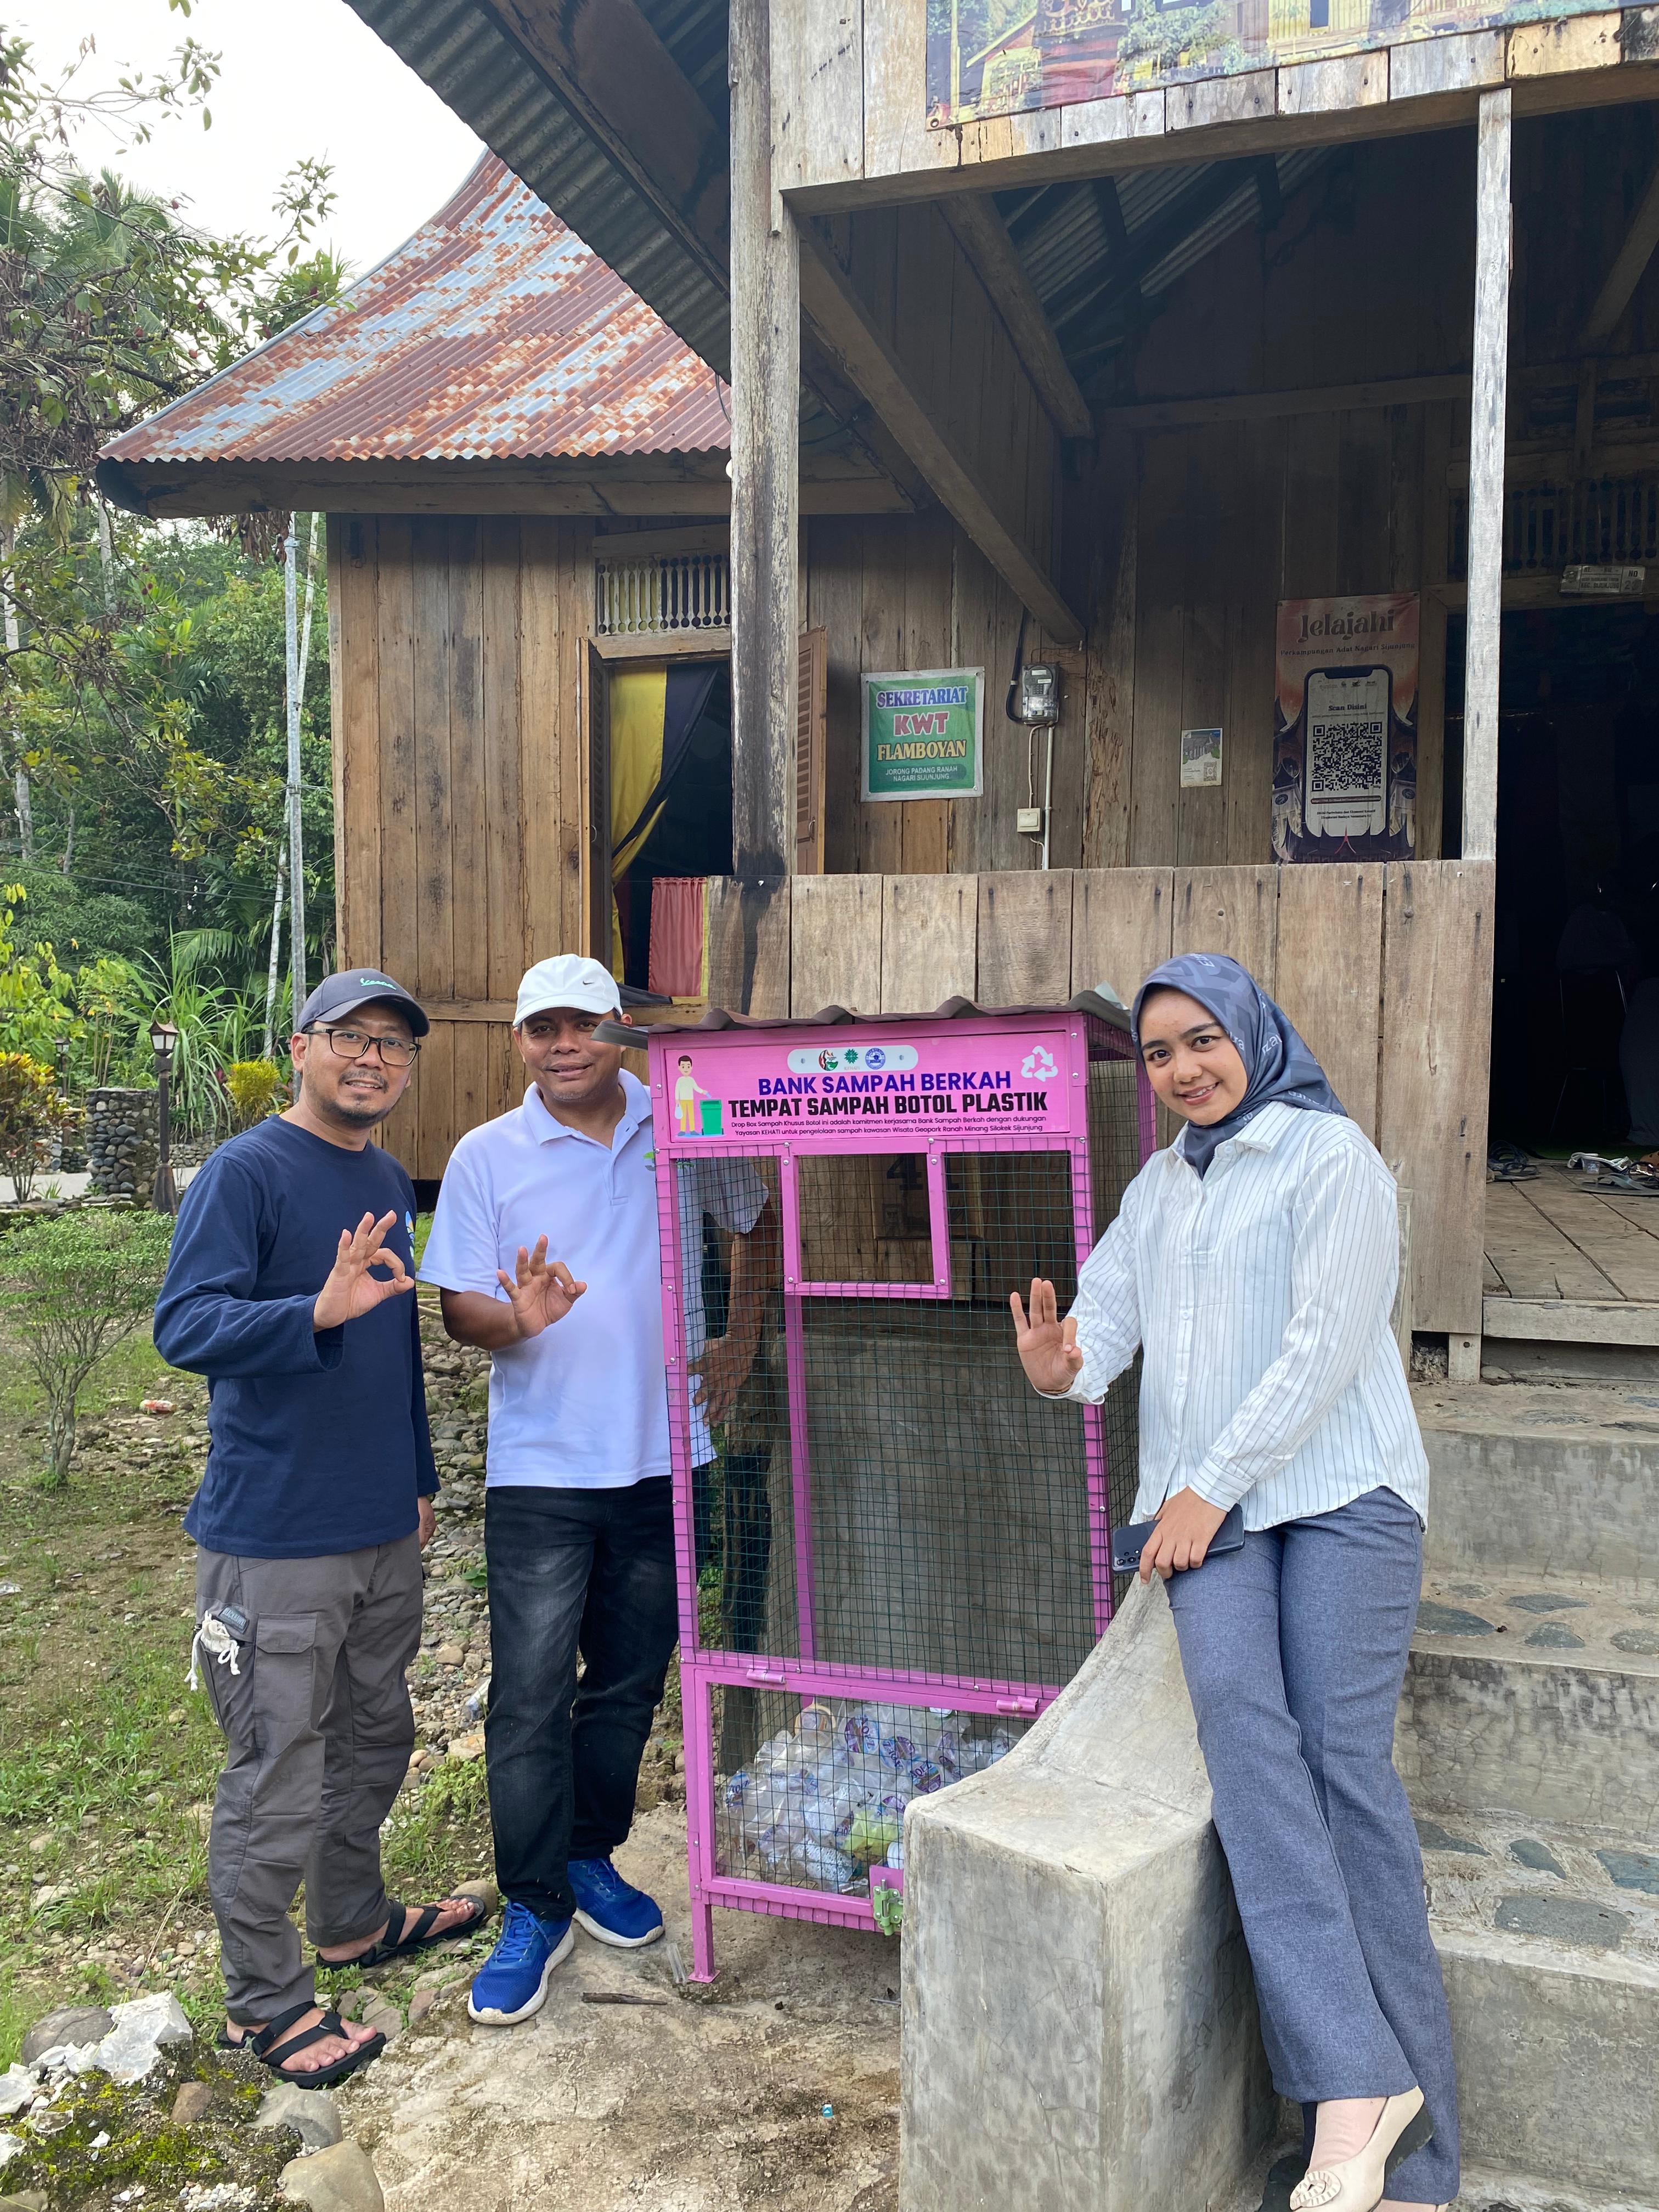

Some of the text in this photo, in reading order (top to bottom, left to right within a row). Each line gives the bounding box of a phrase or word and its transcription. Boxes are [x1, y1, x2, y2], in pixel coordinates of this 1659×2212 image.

[1297, 609, 1395, 644] Jelajahi
[876, 686, 968, 708] SEKRETARIAT
[894, 712, 949, 736] KWT
[877, 740, 966, 761] FLAMBOYAN
[759, 1071, 1011, 1095] BANK SAMPAH BERKAH
[729, 1092, 1048, 1118] TEMPAT SAMPAH BOTOL PLASTIK
